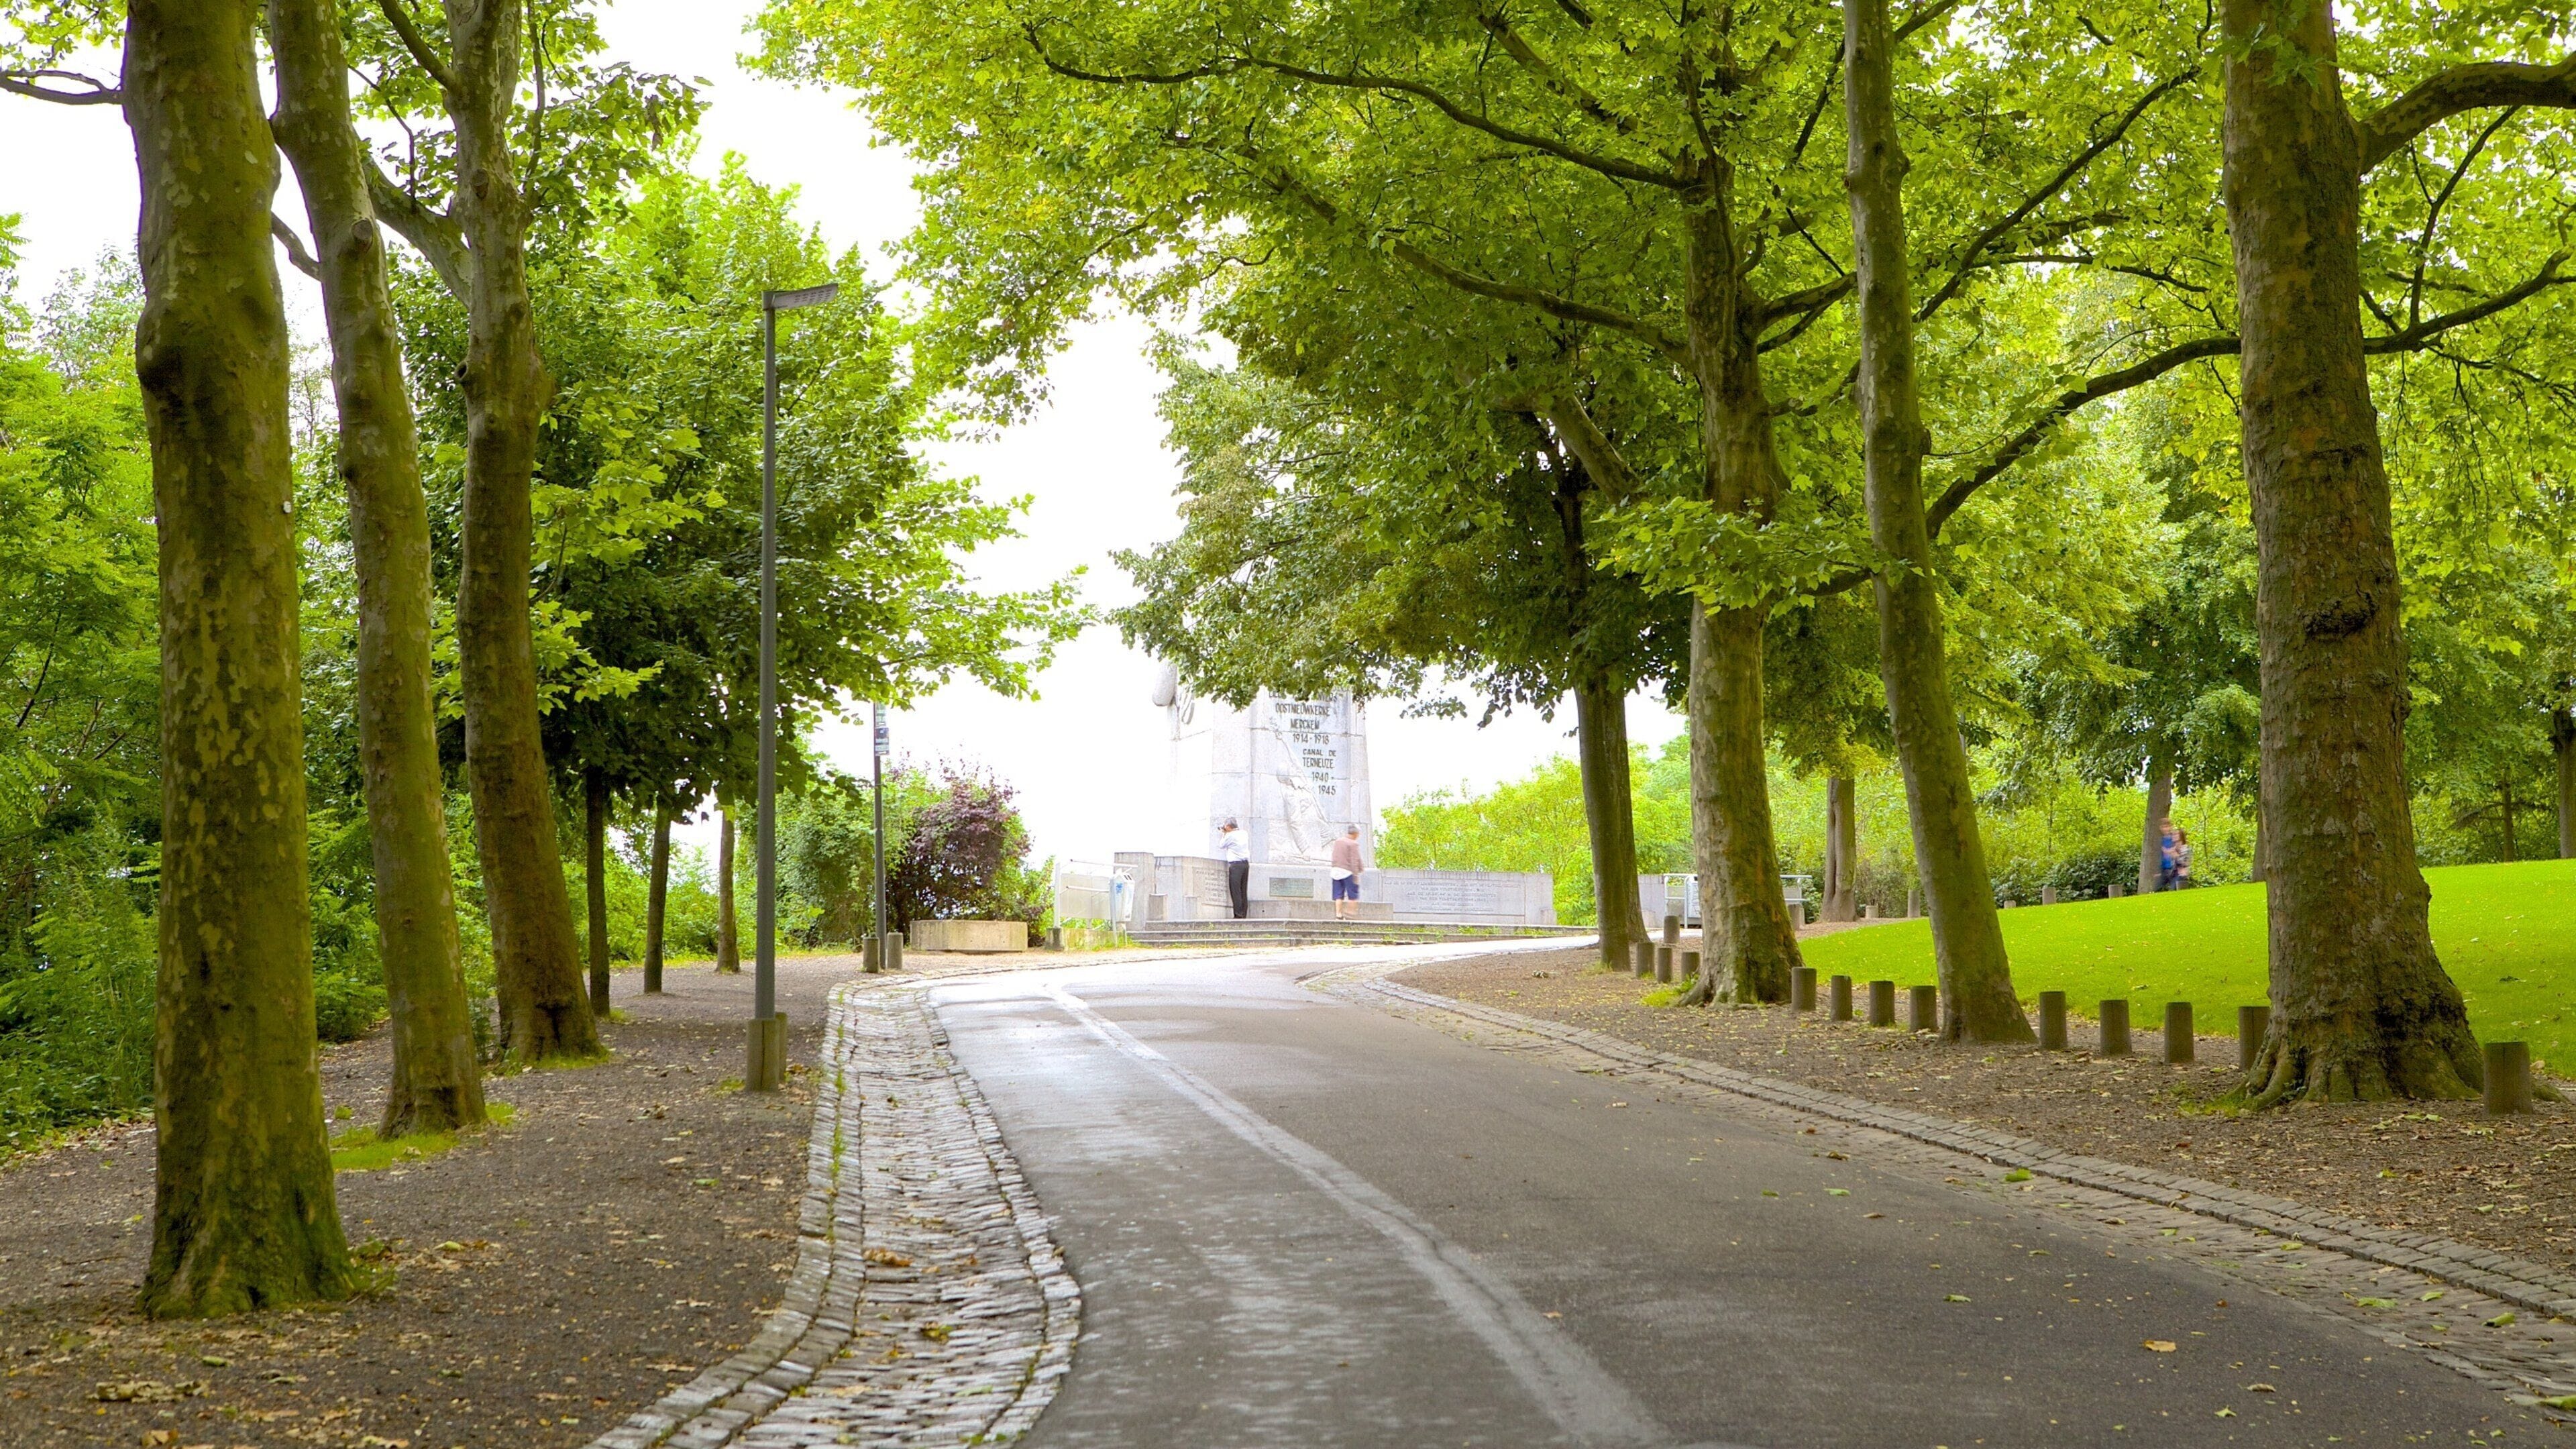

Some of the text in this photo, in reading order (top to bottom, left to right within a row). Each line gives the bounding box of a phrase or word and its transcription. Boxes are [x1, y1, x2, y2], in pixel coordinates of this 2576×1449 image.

[1303, 748, 1337, 757] CANAL DE
[1318, 784, 1336, 796] 1945
